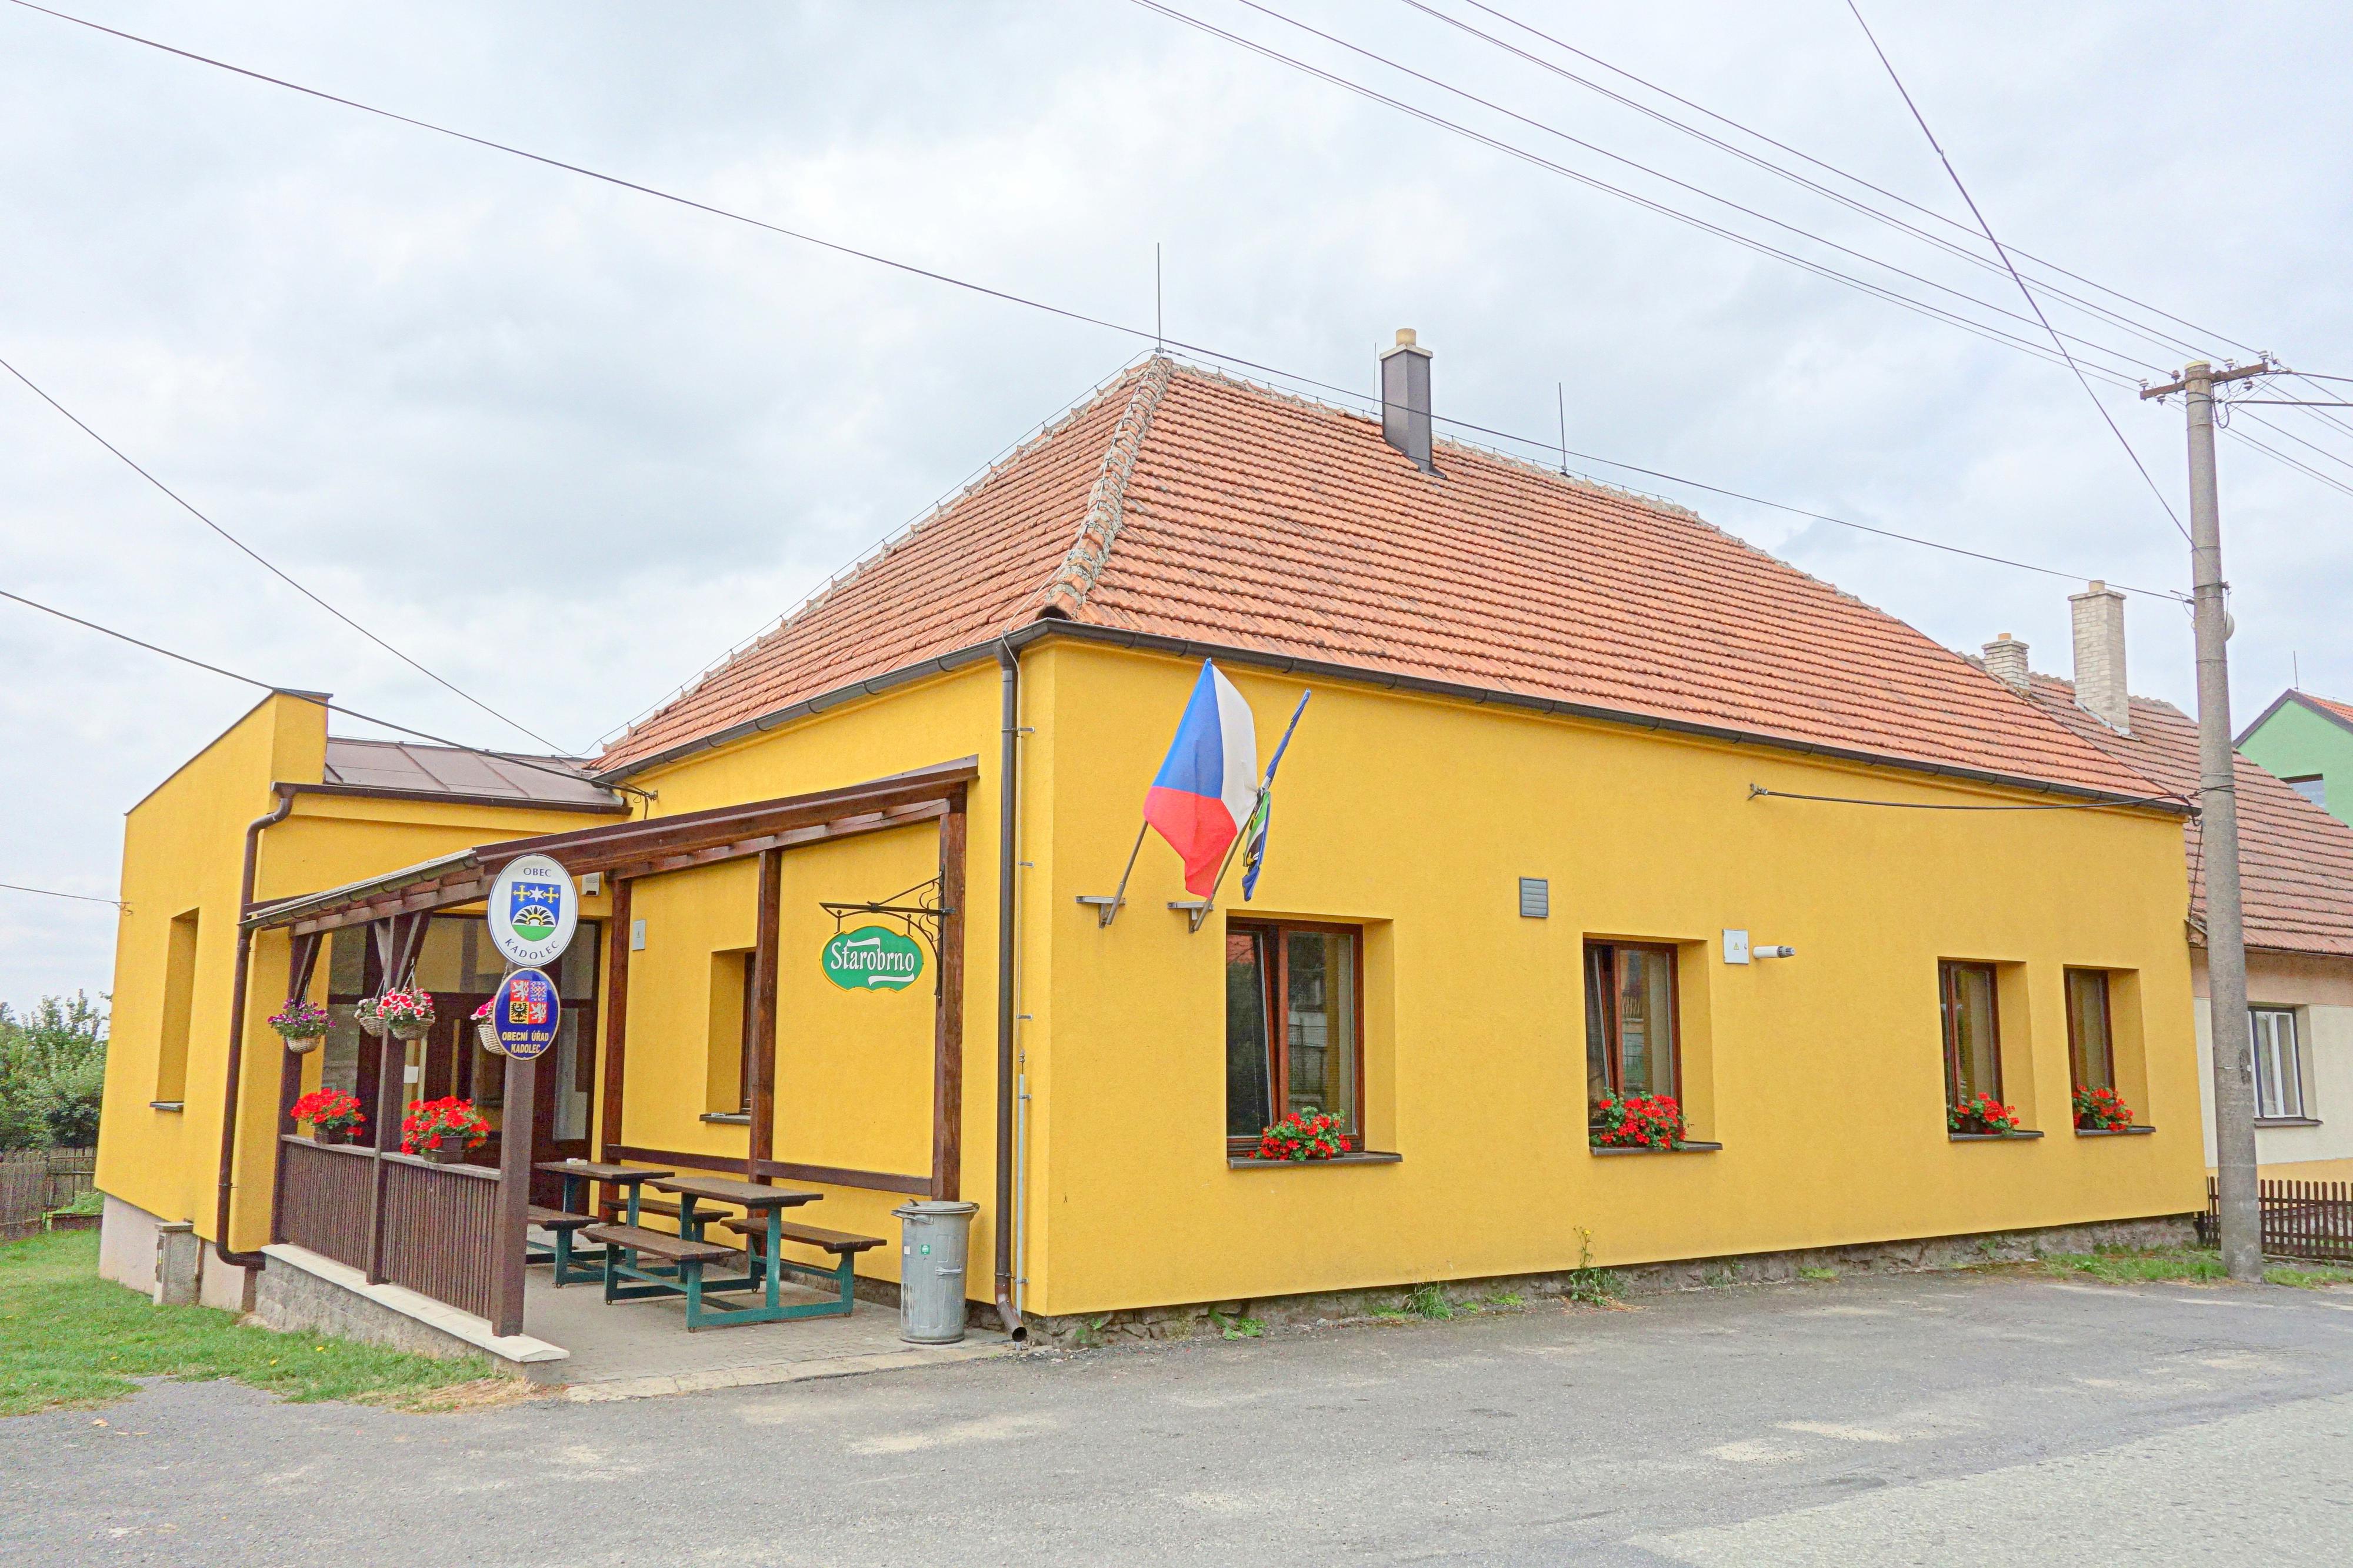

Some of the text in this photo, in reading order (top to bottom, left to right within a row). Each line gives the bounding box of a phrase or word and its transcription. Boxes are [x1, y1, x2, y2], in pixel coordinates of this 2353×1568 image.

[524, 868, 551, 877] OBEC
[505, 938, 559, 959] KADOLEC
[831, 938, 915, 972] Starobrno
[502, 1030, 549, 1041] OBECNÍ ÚŘAD
[511, 1044, 541, 1054] KADOLEC
